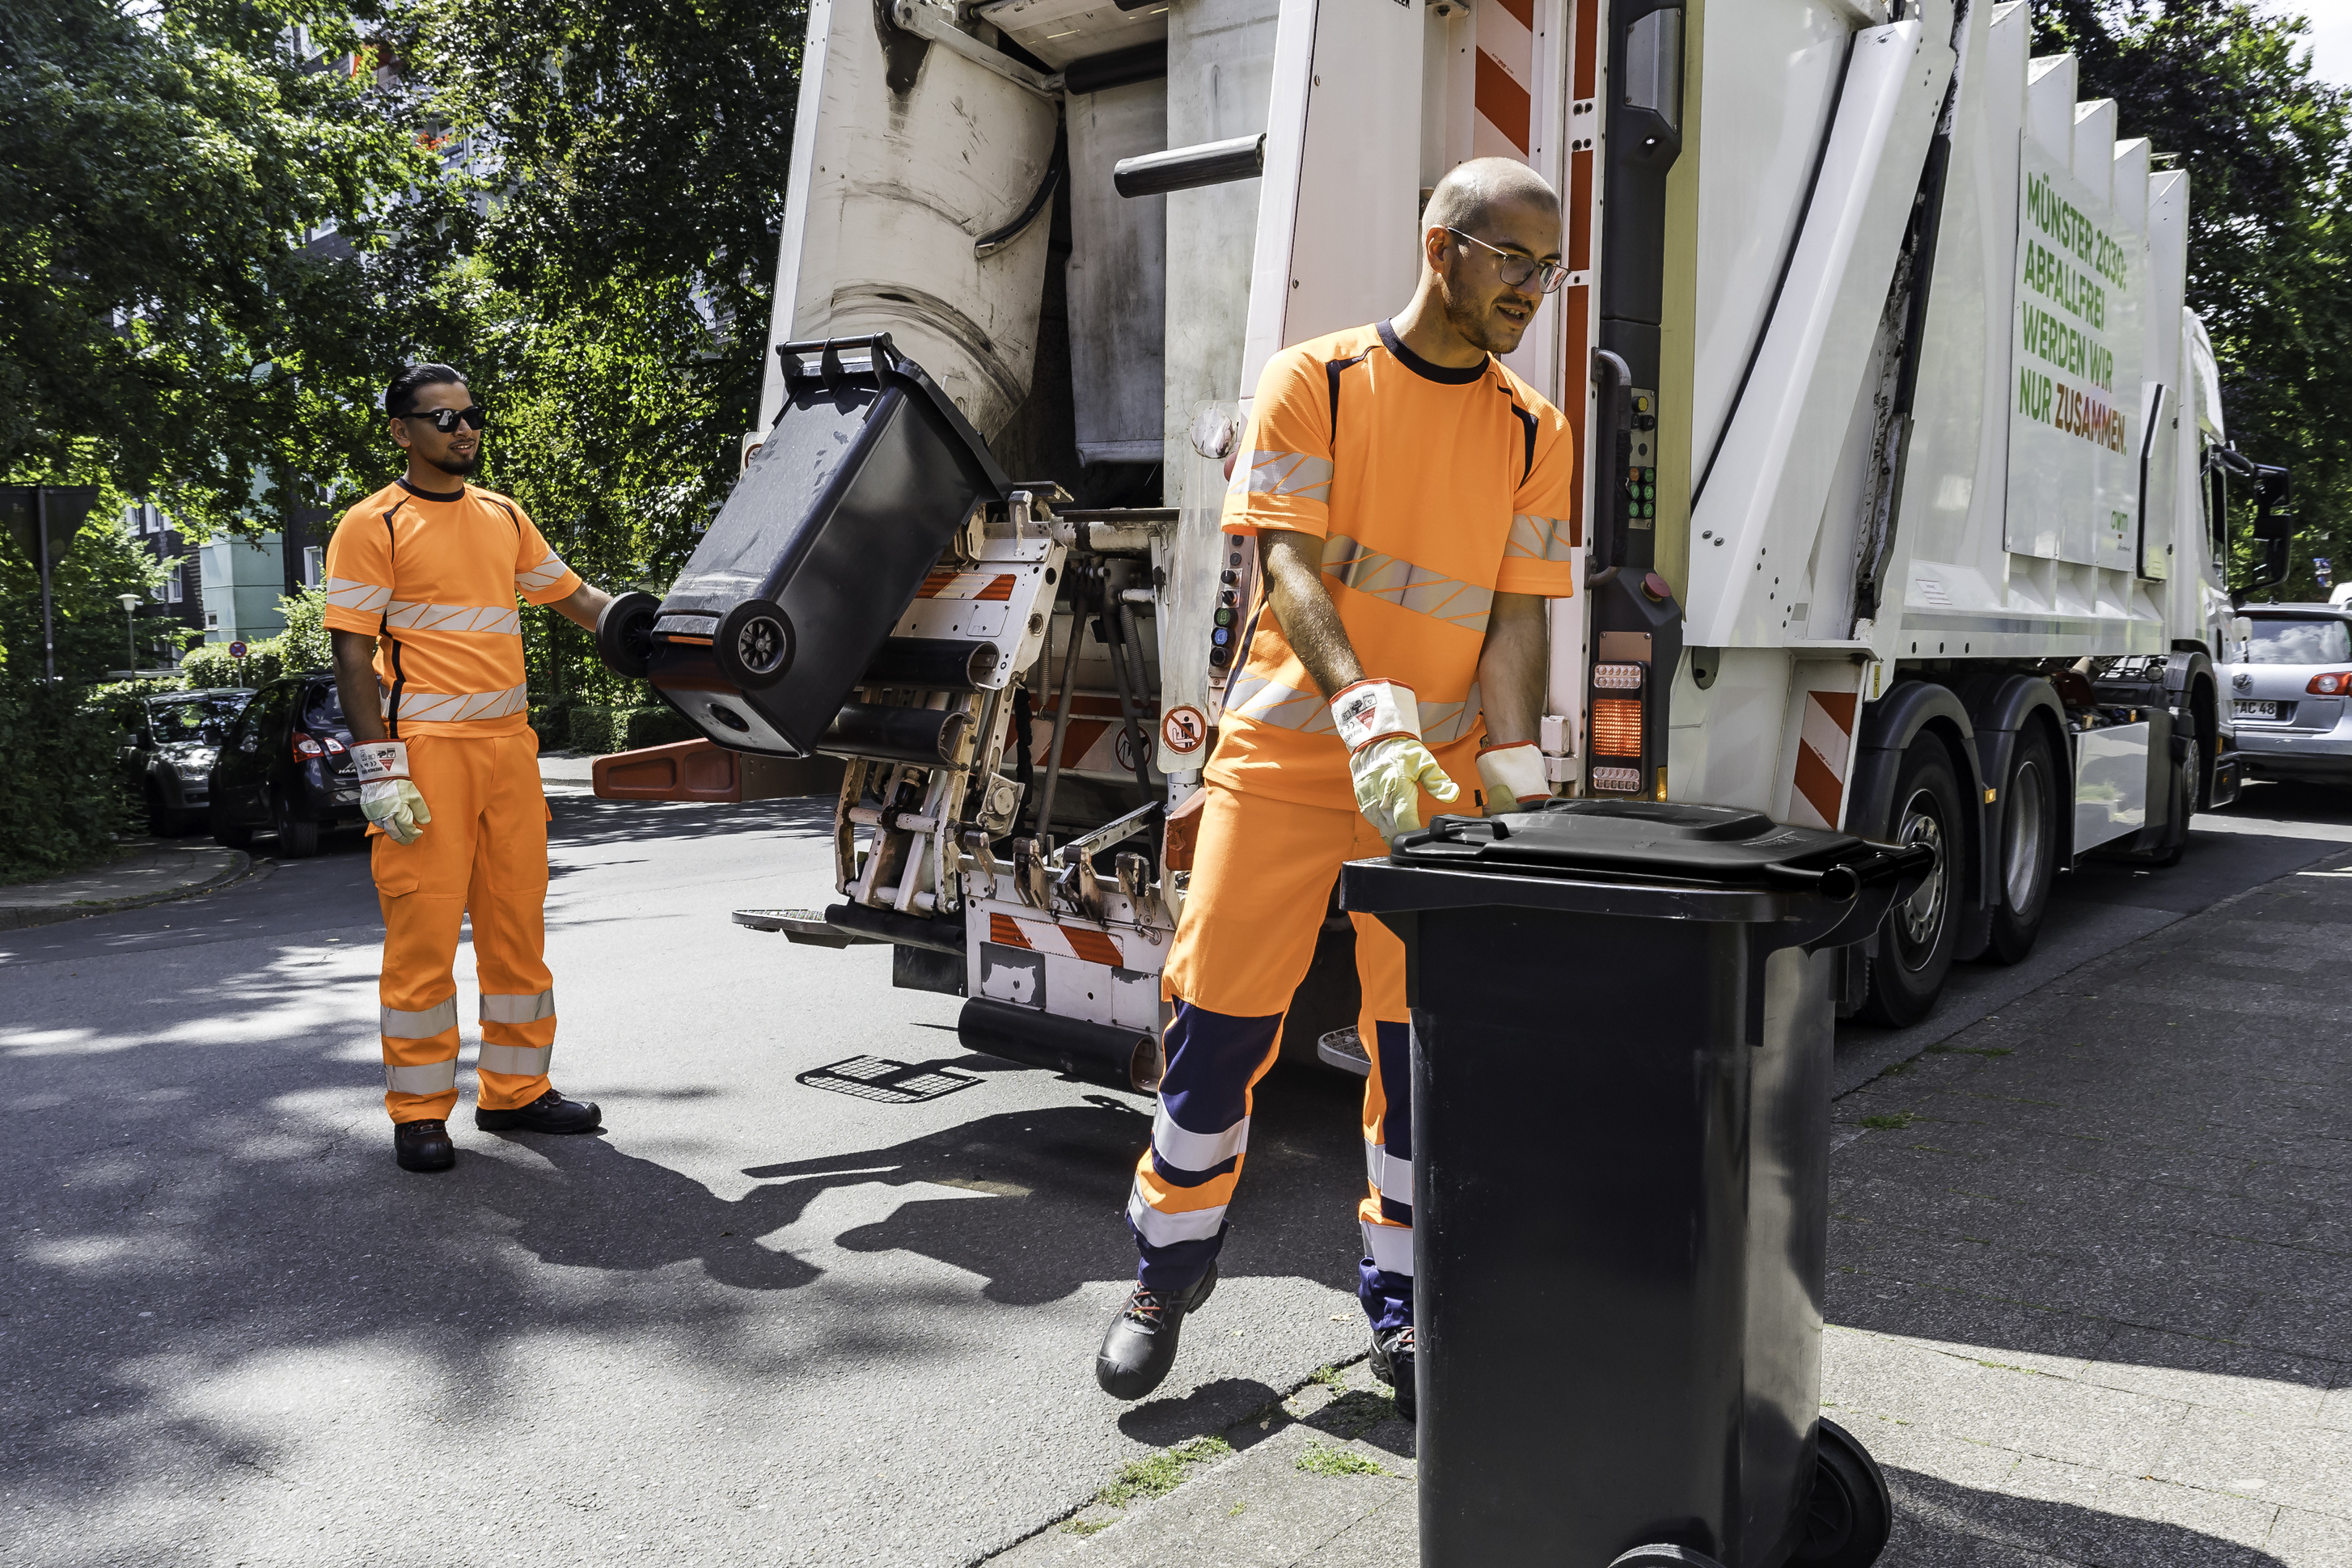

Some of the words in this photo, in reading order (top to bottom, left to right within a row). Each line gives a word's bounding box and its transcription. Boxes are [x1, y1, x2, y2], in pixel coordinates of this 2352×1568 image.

[2027, 171, 2093, 266] MÜNSTER
[2096, 229, 2127, 293] 2030:
[2024, 239, 2105, 332] ABFALLFREI
[2023, 301, 2087, 379] WERDEN
[2089, 340, 2113, 393] WIR
[2019, 366, 2052, 425] NUR
[2054, 382, 2127, 457] ZUSAMMEN.
[2240, 701, 2257, 714] AC
[2259, 702, 2275, 715] 48
